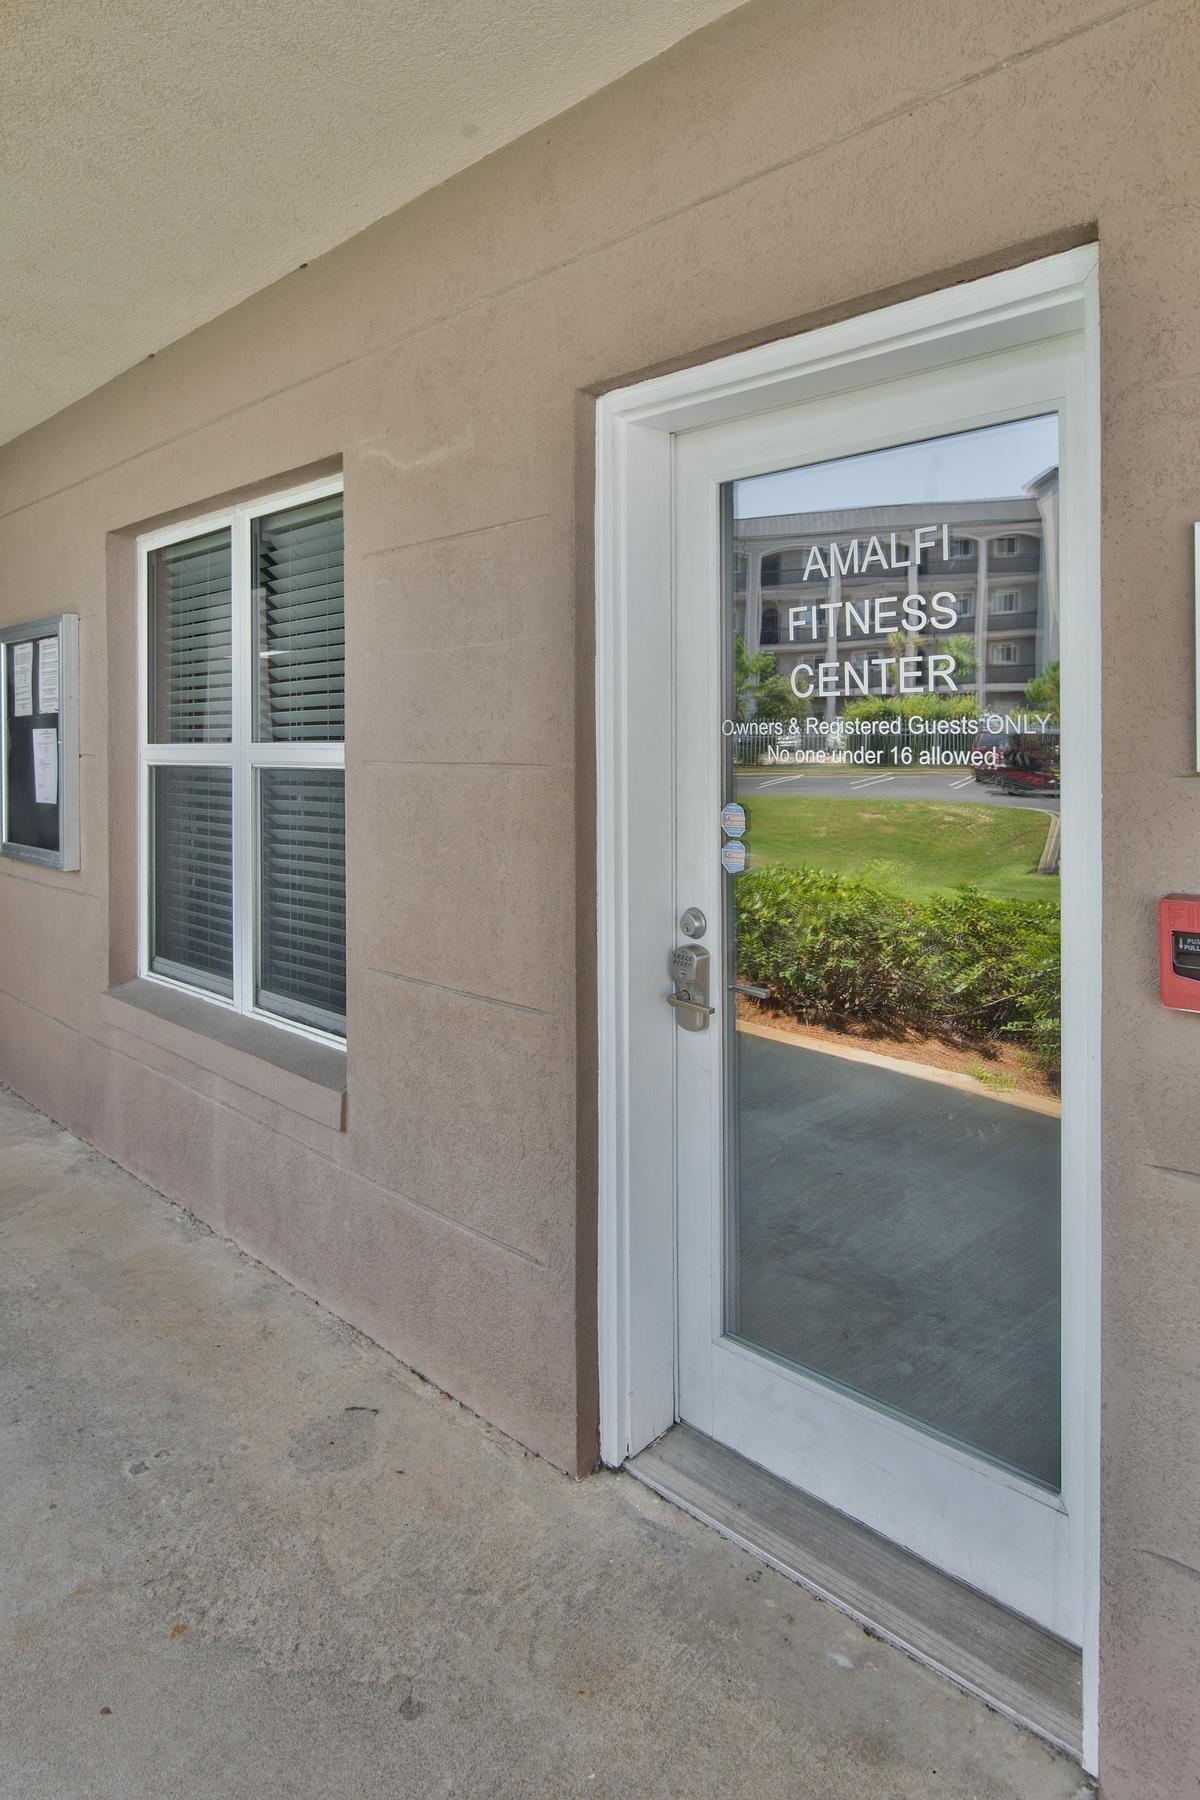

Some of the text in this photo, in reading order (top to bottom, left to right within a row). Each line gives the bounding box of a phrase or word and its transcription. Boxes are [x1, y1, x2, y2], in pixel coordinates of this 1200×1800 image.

[802, 524, 949, 581] AMALFI
[788, 591, 958, 641] FITNESS
[790, 654, 958, 698] CENTER
[722, 713, 1052, 740] Owners & Registered Guests ONLY
[767, 745, 997, 766] No one under 16 allowed
